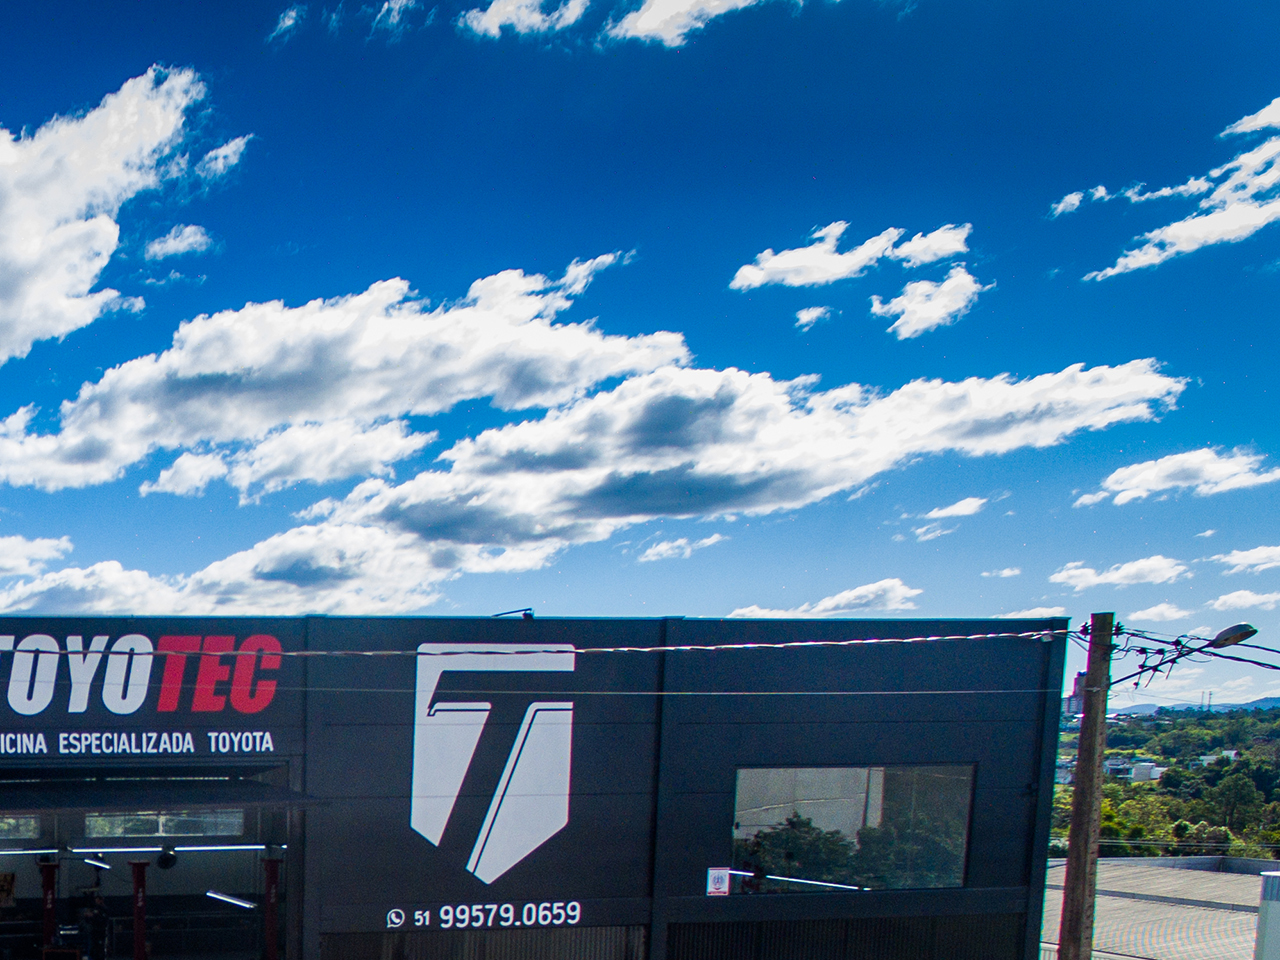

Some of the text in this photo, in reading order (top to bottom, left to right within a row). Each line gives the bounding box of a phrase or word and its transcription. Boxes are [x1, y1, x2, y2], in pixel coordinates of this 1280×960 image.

[58, 732, 195, 754] ESPECIALIZADA
[207, 731, 274, 752] TOYOTA
[414, 901, 581, 928] 51 99579.0659
